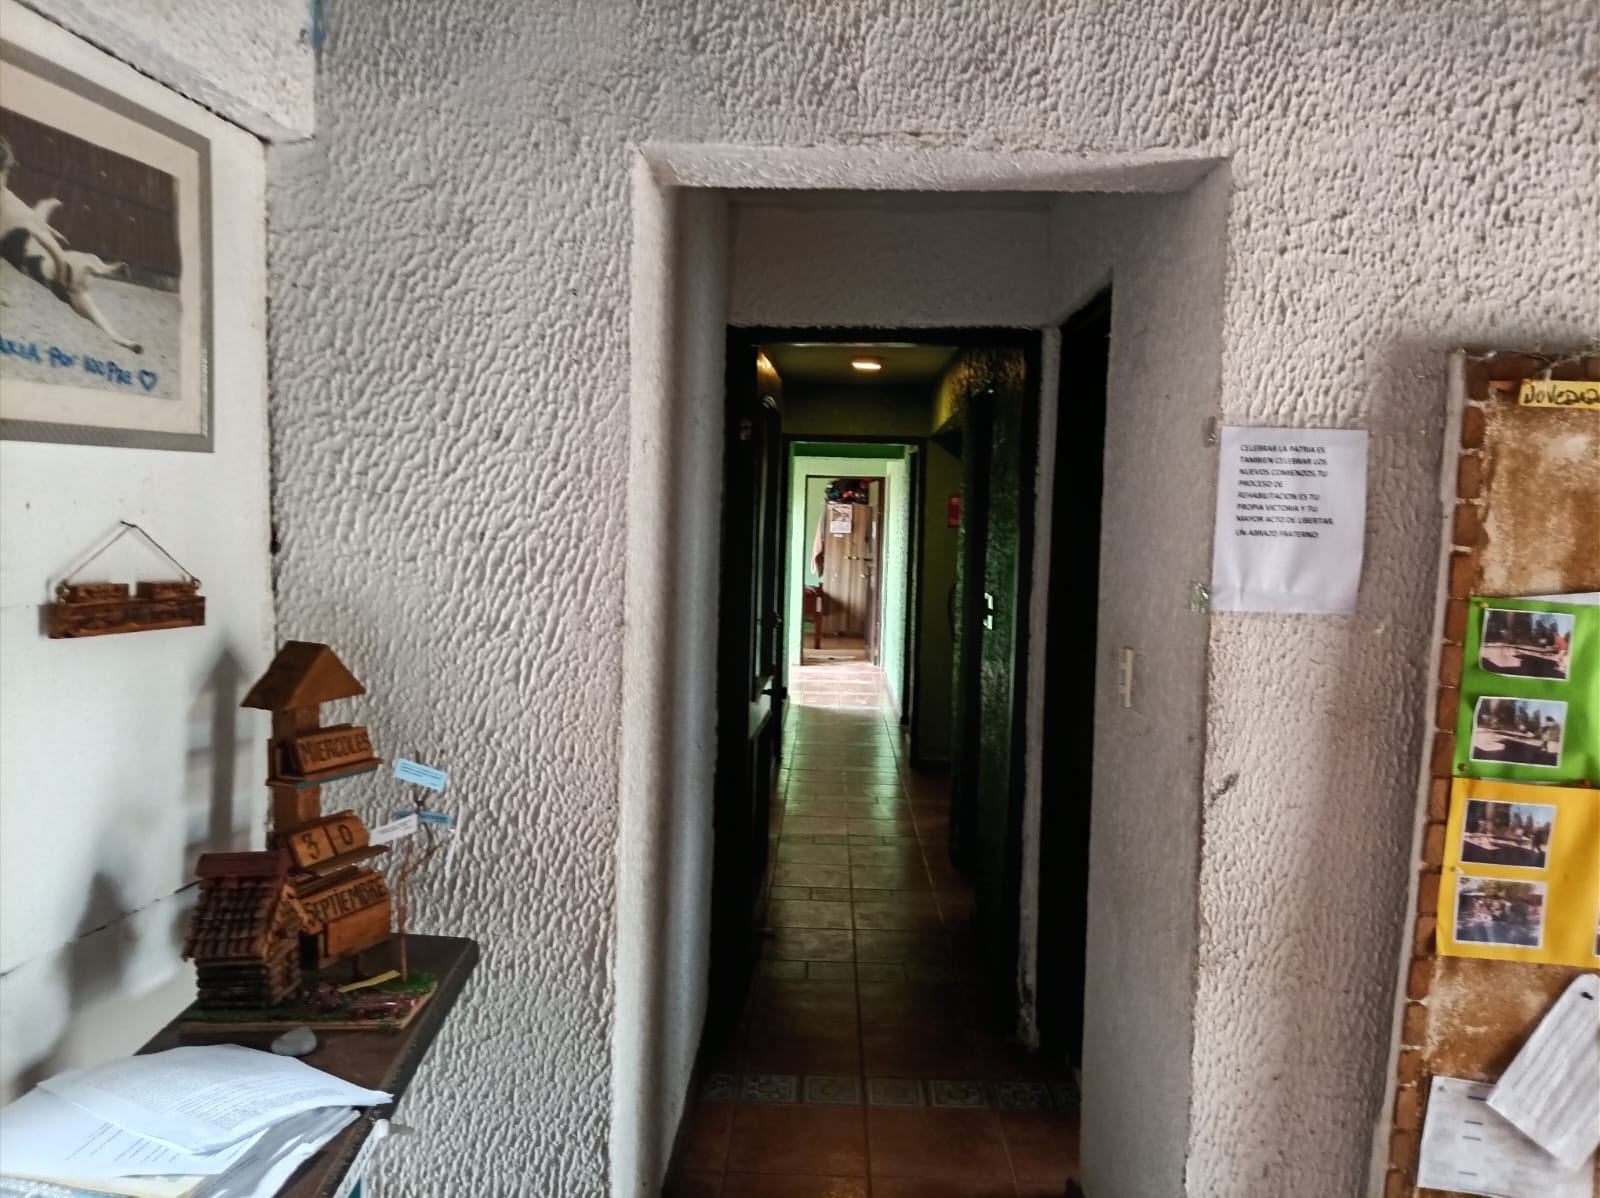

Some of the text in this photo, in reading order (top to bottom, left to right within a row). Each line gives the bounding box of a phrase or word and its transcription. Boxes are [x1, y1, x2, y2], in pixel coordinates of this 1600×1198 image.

[1240, 444, 1326, 454] CELEBRAR LA PATRIA ES
[1275, 457, 1312, 465] CELEBRAR
[1313, 458, 1328, 466] LOS
[1239, 468, 1270, 476] NUEVOS
[1238, 479, 1283, 488] PROCESO DE
[1309, 493, 1321, 501] TU
[1236, 503, 1264, 511] PROPIA
[1265, 504, 1299, 512] VICTORIA
[1266, 515, 1285, 523] ACTO
[1235, 529, 1247, 537] UN
[1248, 529, 1278, 537] ABRAZO
